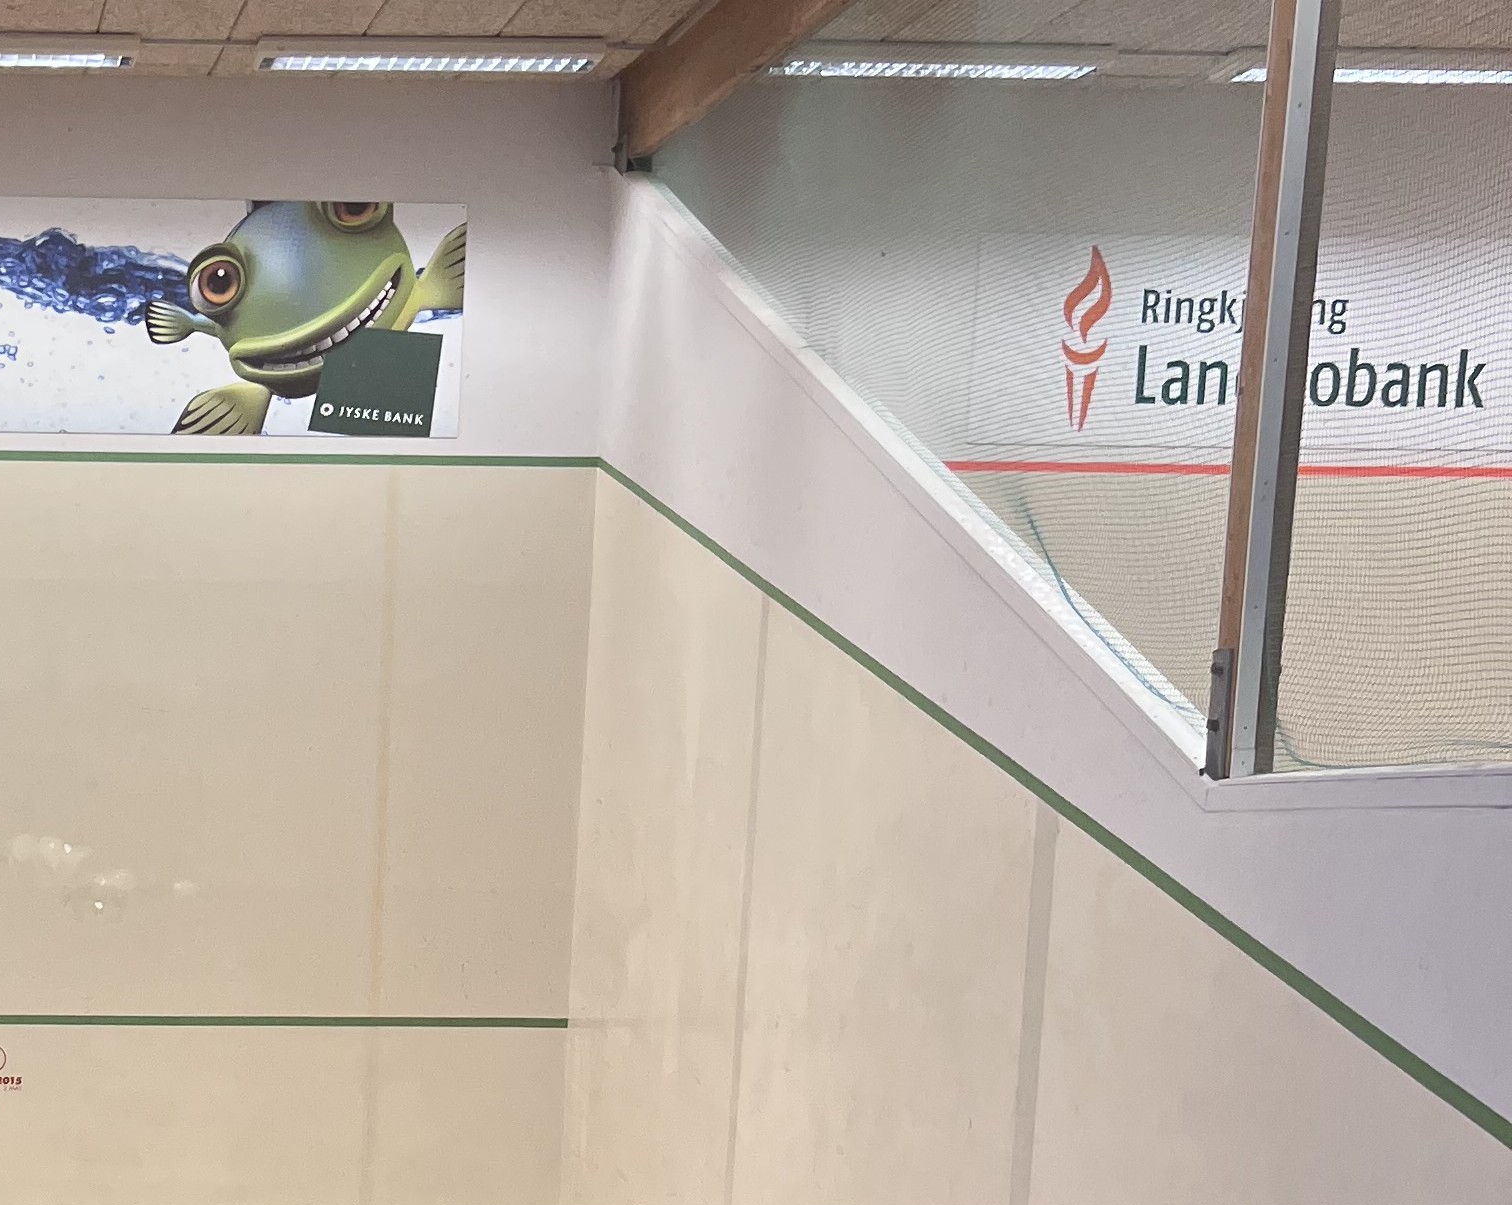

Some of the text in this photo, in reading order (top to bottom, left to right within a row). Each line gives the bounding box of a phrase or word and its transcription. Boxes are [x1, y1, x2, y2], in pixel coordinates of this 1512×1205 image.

[1135, 344, 1487, 409] Lanobank
[339, 405, 425, 426] JYSKE BANK
